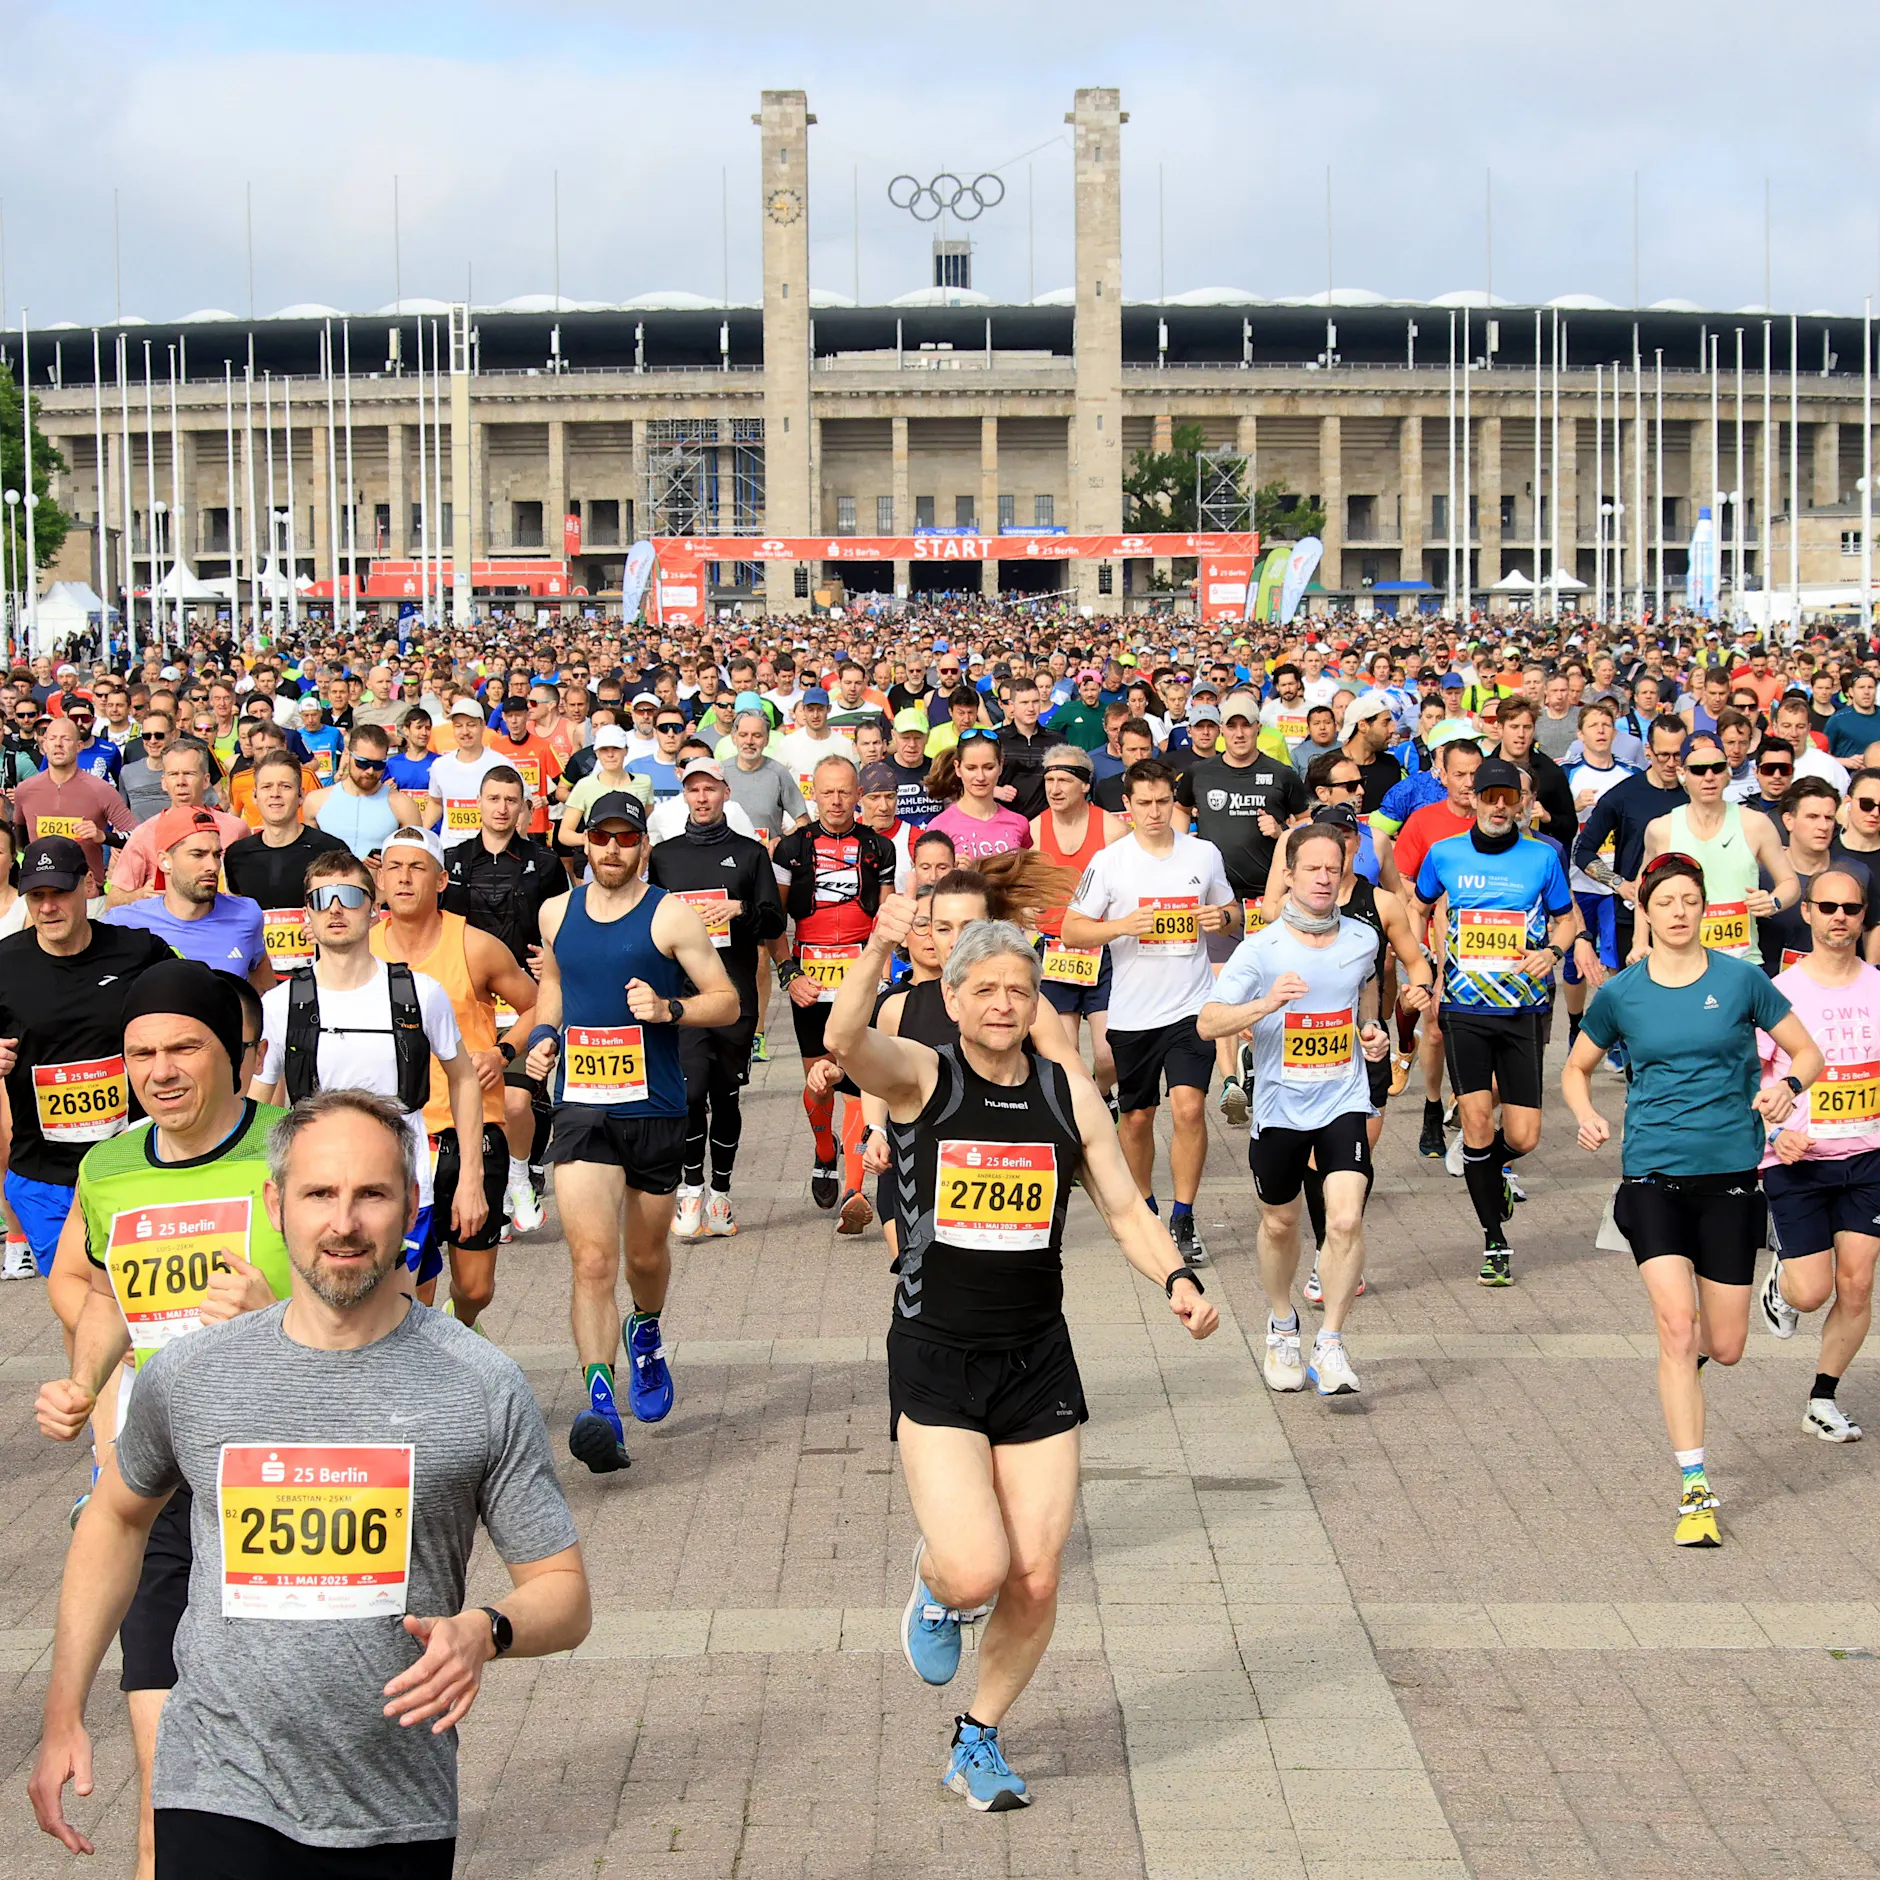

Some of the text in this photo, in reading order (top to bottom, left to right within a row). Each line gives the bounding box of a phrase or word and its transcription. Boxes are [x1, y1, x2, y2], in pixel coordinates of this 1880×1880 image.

[843, 548, 880, 556] 25 Berlin
[914, 539, 992, 558] START
[1054, 546, 1079, 554] Berlin
[1229, 793, 1266, 809] XLETIX
[41, 822, 75, 834] 2621
[1458, 875, 1486, 888] IVU
[1151, 916, 1194, 934] 6938
[1702, 922, 1743, 942] 7946
[266, 930, 307, 948] 6219
[1466, 932, 1517, 949] 29494
[808, 966, 848, 982] 2771
[1049, 958, 1093, 976] 28563
[1822, 1007, 1870, 1020] OWN
[1825, 1026, 1872, 1041] THE
[1292, 1033, 1348, 1056] 29344
[1825, 1046, 1872, 1061] CITY
[574, 1054, 634, 1076] 29175
[83, 1070, 108, 1080] Berlin
[1852, 1071, 1870, 1079] Berlin
[48, 1085, 120, 1116] 26368
[984, 1098, 1028, 1110] hummel
[1818, 1087, 1877, 1111] 26717
[986, 1157, 1032, 1168] 25 Berlin
[950, 1181, 1042, 1212] 27848
[159, 1219, 216, 1236] 25 Berlin
[122, 1250, 231, 1298] 27805
[167, 1311, 182, 1319] MAI
[184, 1308, 203, 1317] 202
[293, 1468, 368, 1482] 25 Berlin
[240, 1508, 388, 1555] 25906
[276, 1576, 293, 1585] 11.
[296, 1576, 318, 1585] MAI
[321, 1576, 348, 1584] 2025
